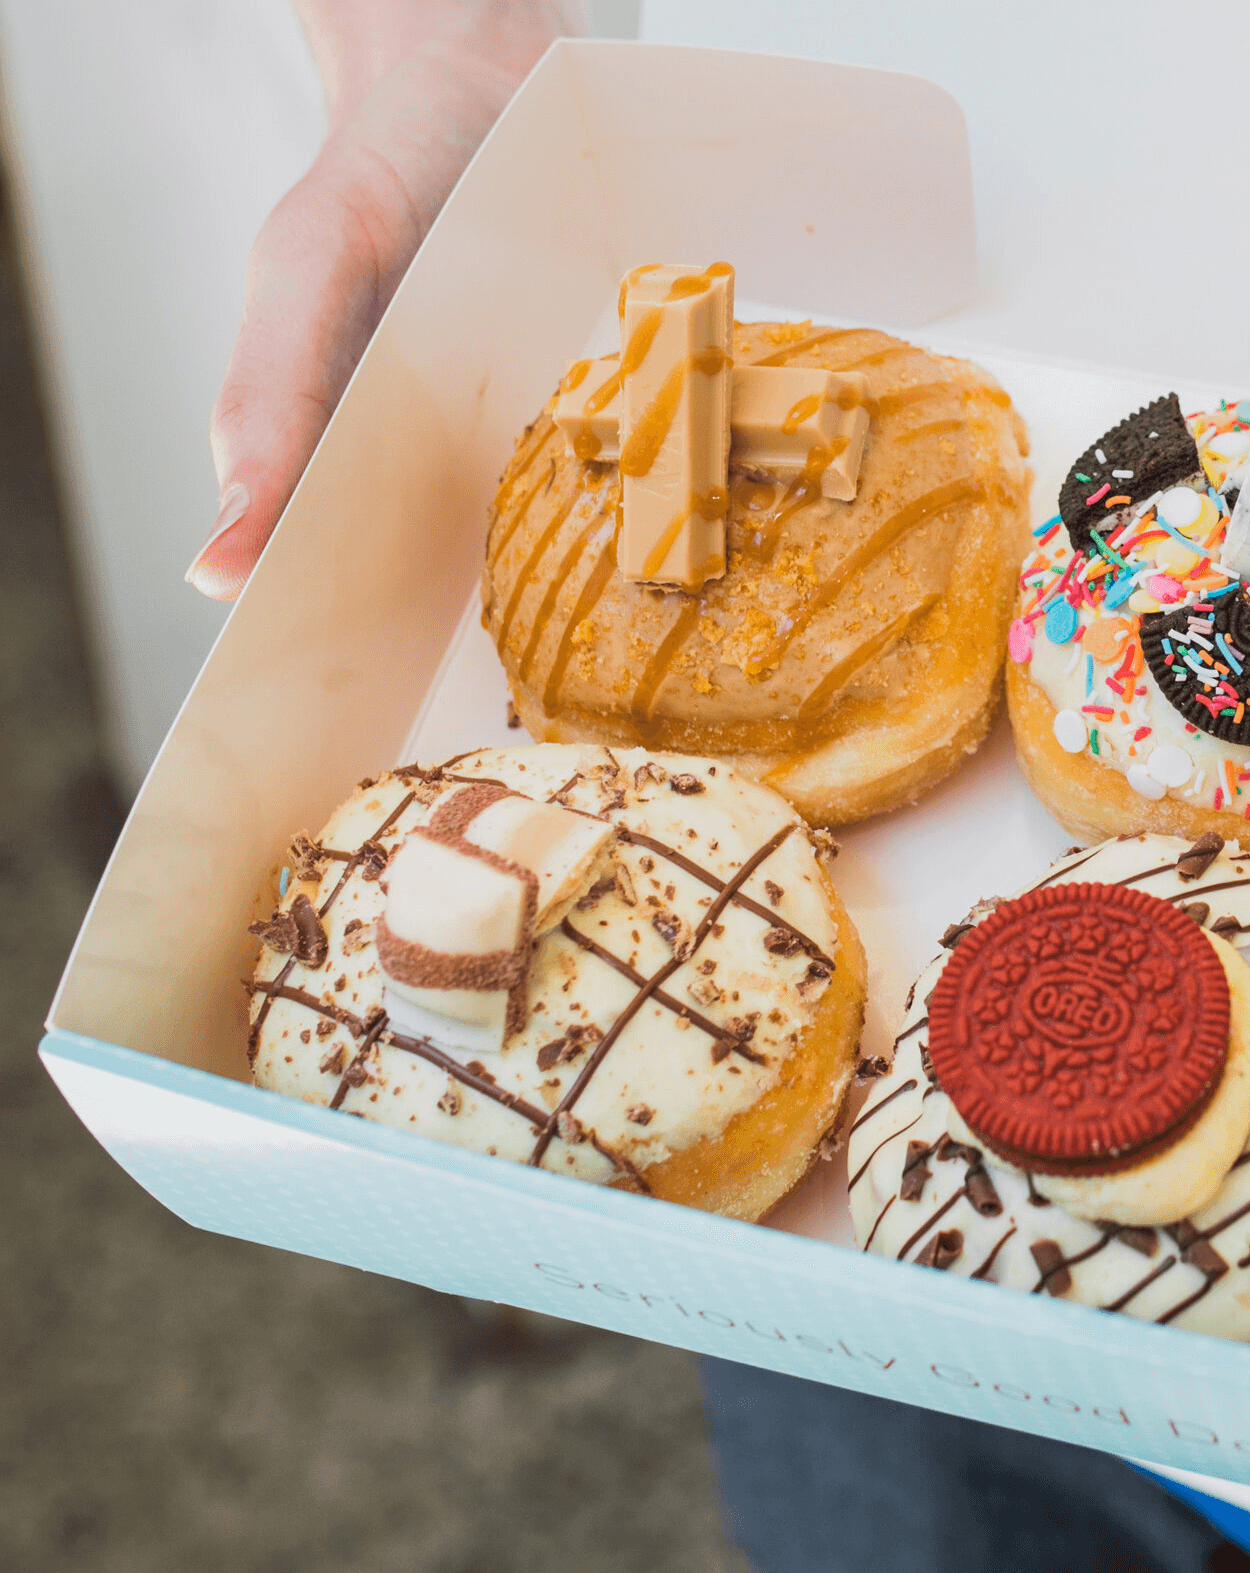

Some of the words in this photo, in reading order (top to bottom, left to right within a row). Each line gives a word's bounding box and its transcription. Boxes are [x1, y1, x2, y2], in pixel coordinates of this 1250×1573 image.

[1033, 986, 1116, 1032] OREO
[534, 1262, 896, 1371] Seriously
[931, 1362, 1130, 1426] Good
